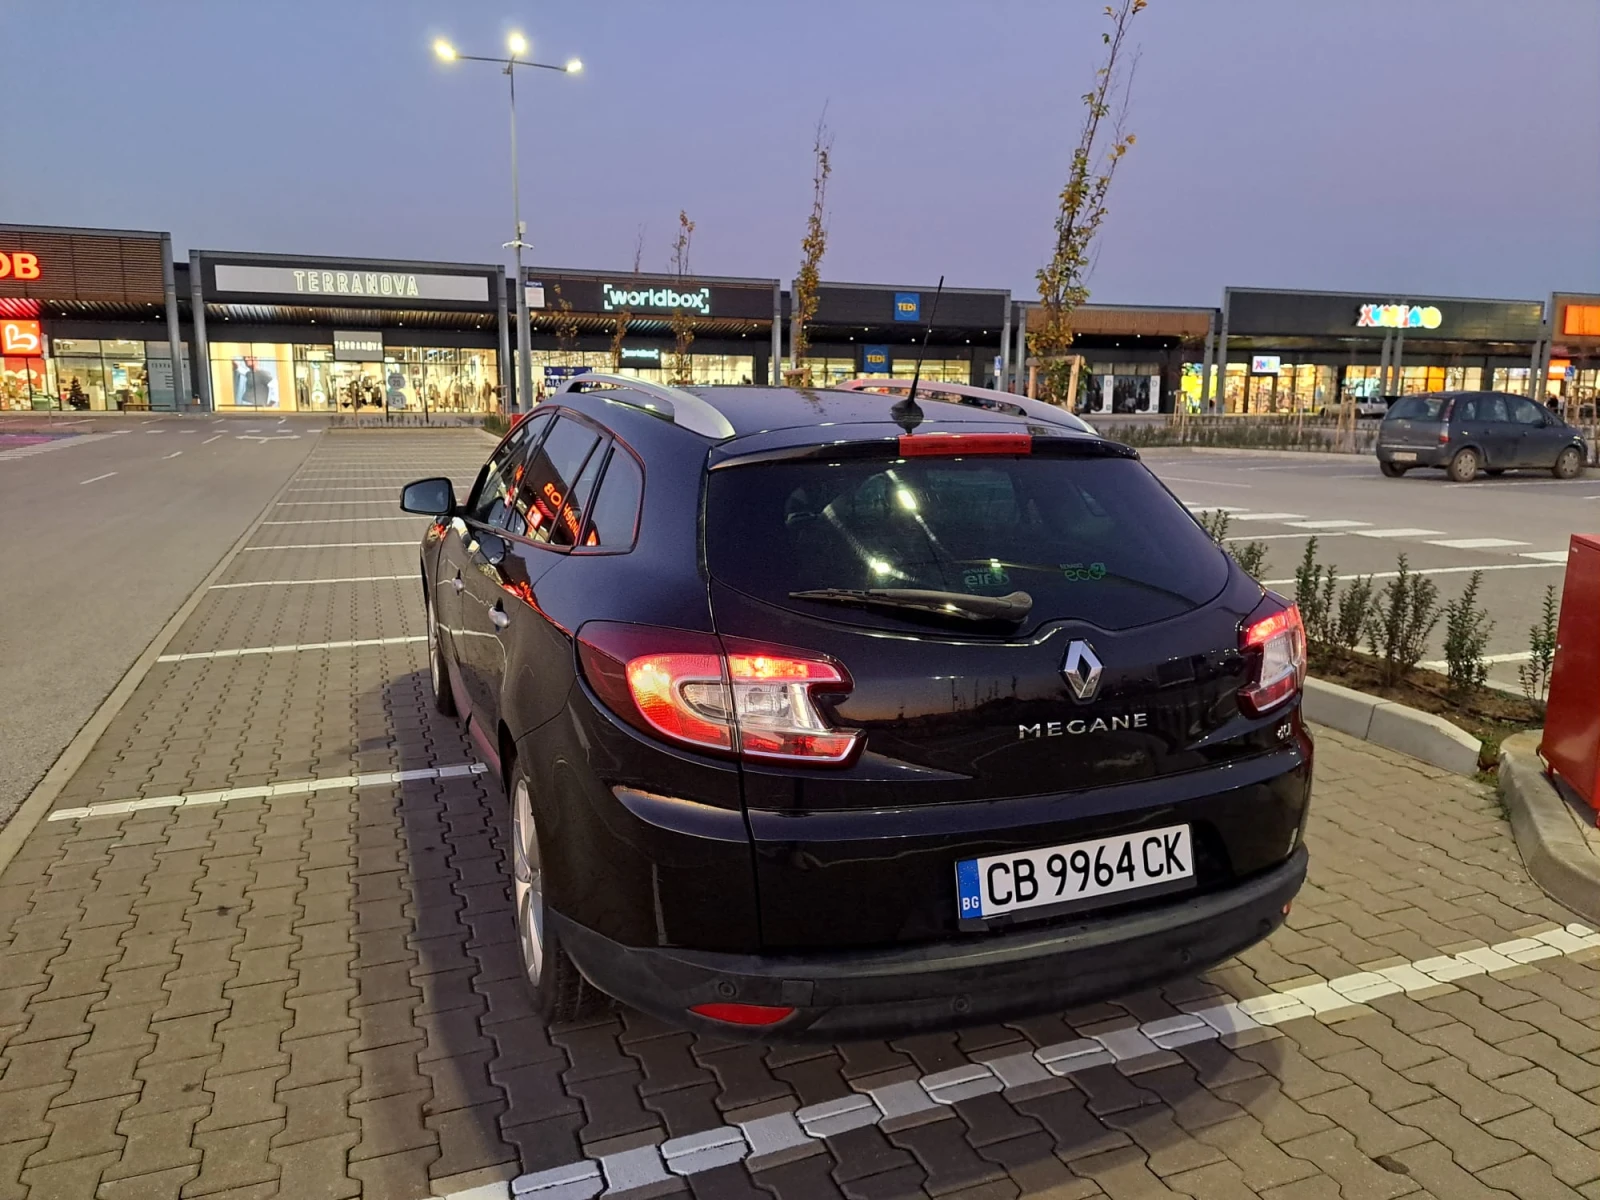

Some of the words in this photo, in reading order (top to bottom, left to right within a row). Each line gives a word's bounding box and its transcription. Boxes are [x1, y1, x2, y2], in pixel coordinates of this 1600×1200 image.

[293, 270, 419, 296] TERRANOVA
[897, 302, 917, 312] TEDi
[334, 340, 383, 351] TERRANOVA
[1018, 713, 1148, 739] MEGANE
[986, 858, 1039, 906] CB
[1046, 840, 1136, 896] 9964
[1142, 832, 1186, 877] CK
[962, 895, 980, 911] BG
